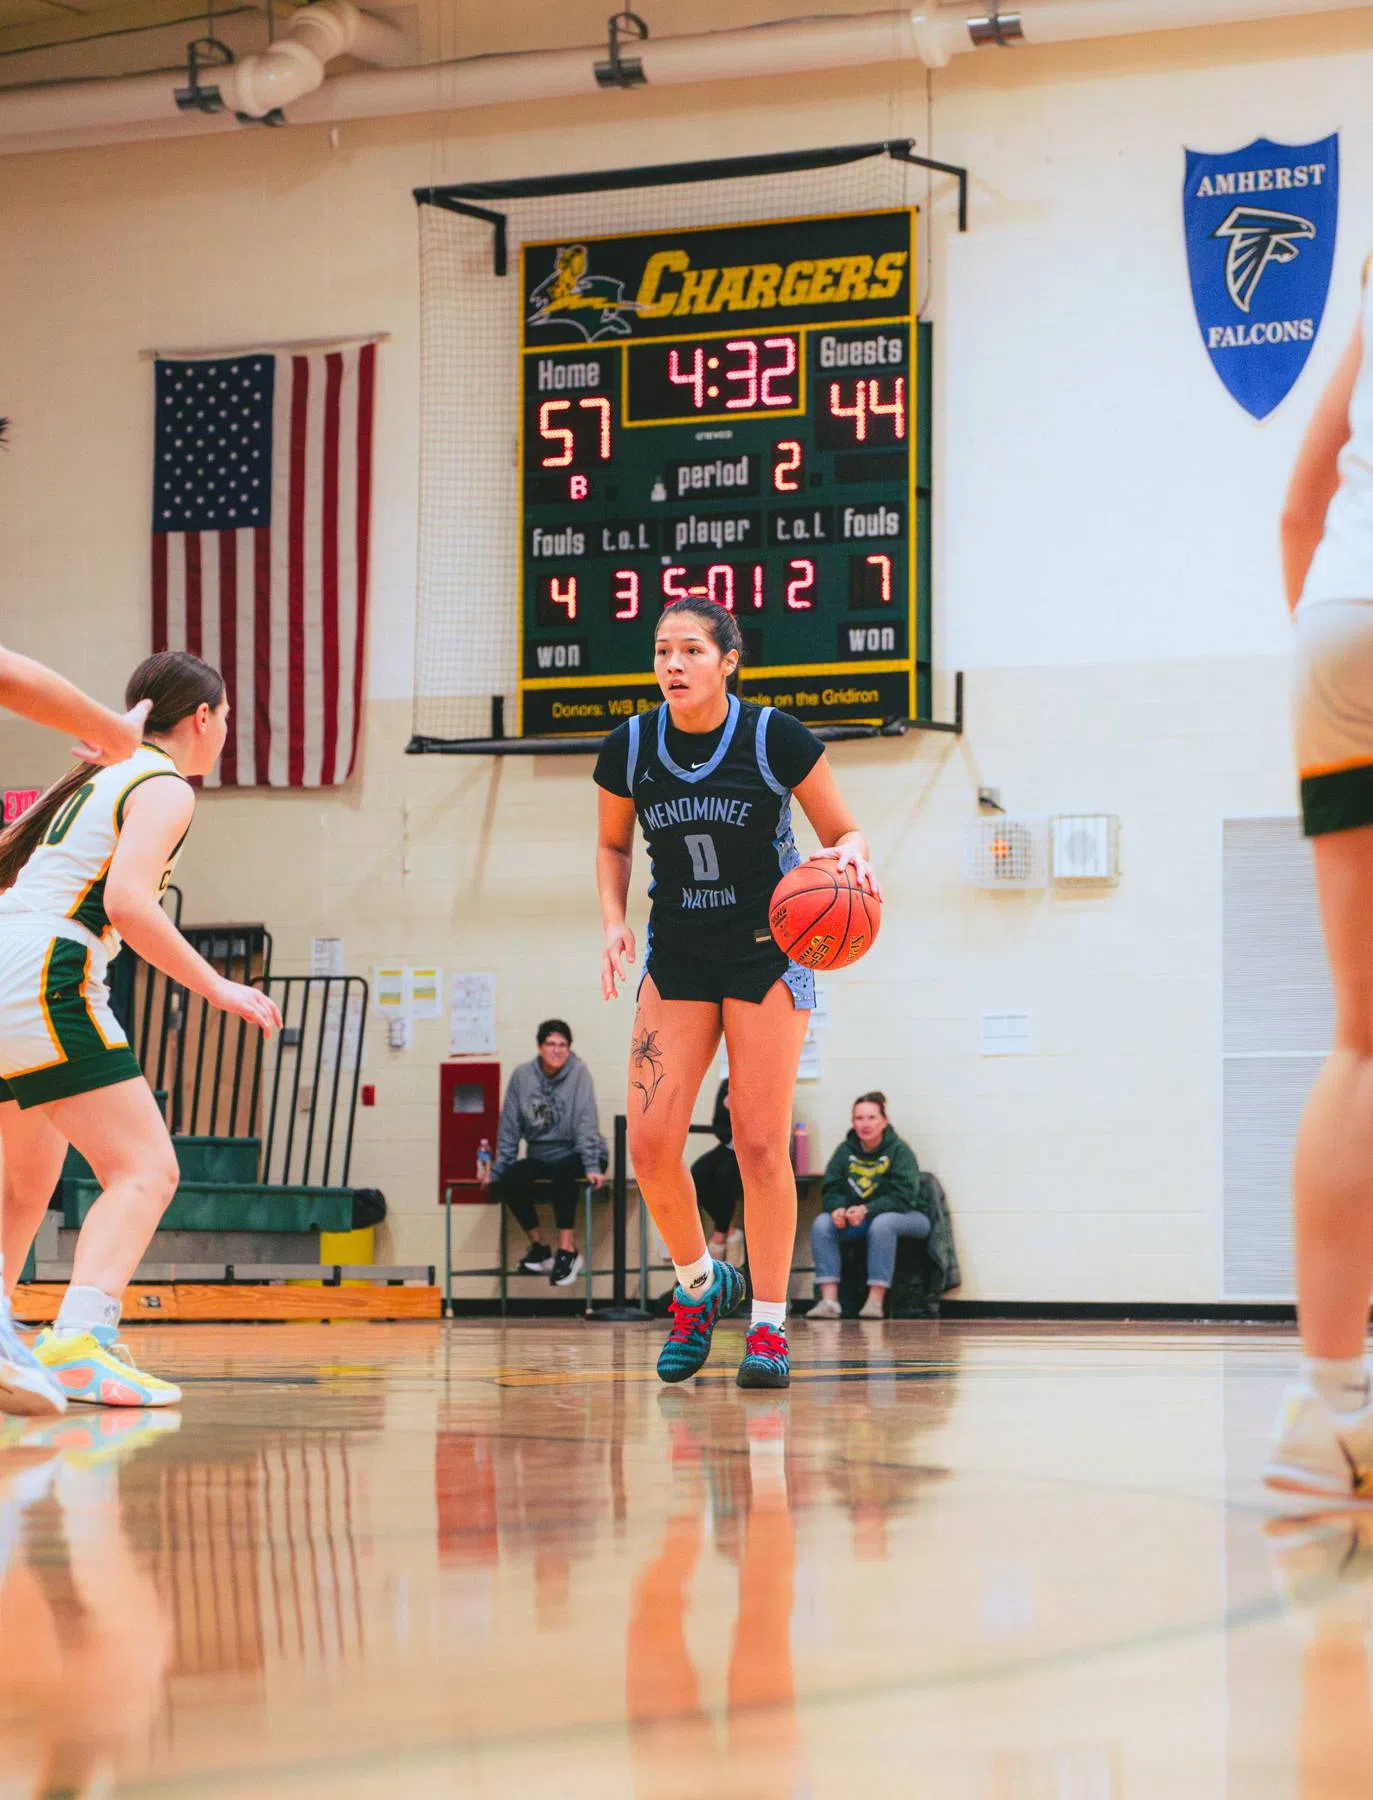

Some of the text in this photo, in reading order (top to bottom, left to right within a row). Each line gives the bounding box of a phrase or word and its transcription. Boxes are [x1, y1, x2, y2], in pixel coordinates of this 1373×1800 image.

[1196, 163, 1326, 197] AMHERST
[820, 335, 903, 368] Guests
[1207, 318, 1314, 348] FALCONS
[538, 359, 600, 391] Home
[669, 337, 796, 408] 4:32
[830, 377, 905, 441] 44
[540, 397, 610, 467] 57
[678, 455, 749, 496] period
[774, 441, 801, 491] 2
[675, 514, 751, 552] player
[843, 506, 899, 538] fouls
[532, 526, 586, 557] fouls
[615, 570, 639, 619] 3
[787, 559, 815, 609] 2
[866, 555, 891, 602] 7
[551, 577, 577, 619] 4
[536, 644, 580, 668] won
[849, 627, 895, 653] won
[774, 694, 793, 707] on
[795, 692, 819, 707] the
[822, 688, 879, 706] Gridiron
[643, 797, 753, 832] MENOMINEE
[684, 834, 720, 881] 0
